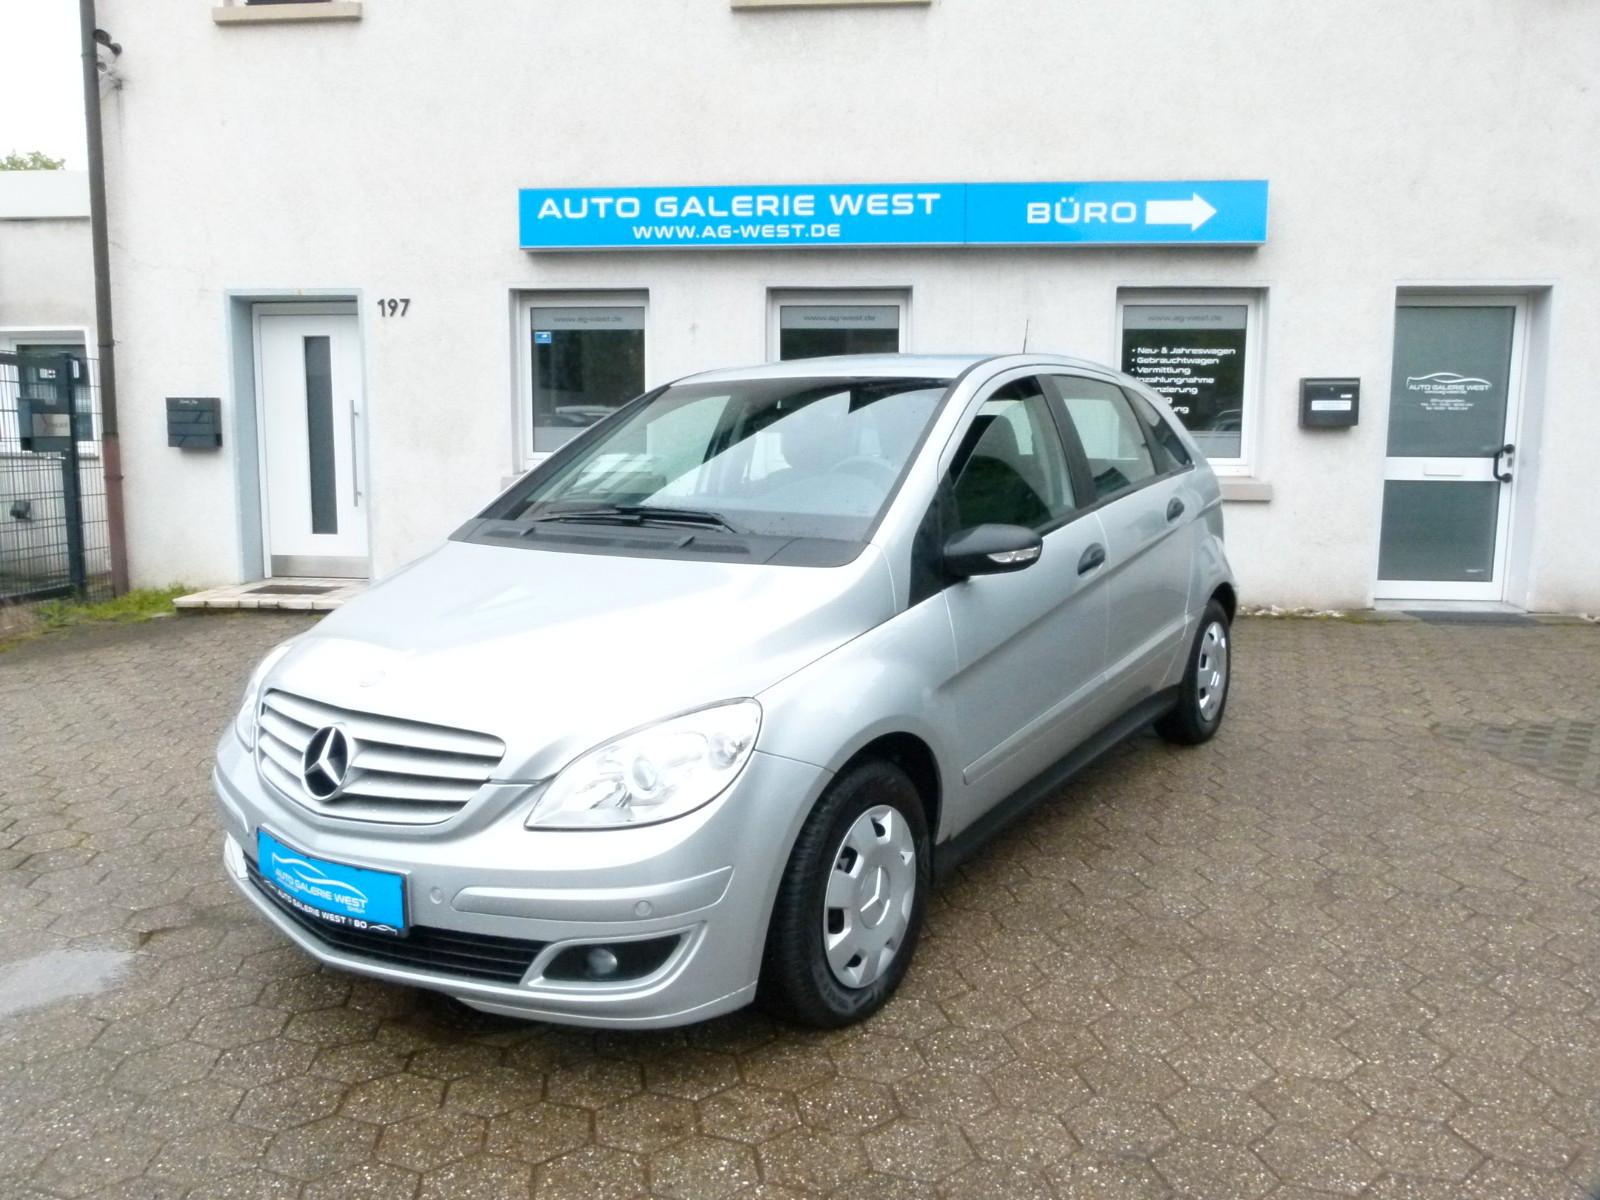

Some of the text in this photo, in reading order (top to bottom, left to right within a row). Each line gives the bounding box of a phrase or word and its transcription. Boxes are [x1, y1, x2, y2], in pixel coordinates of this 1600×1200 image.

[537, 192, 941, 219] AUTO GALERIE WEST
[1026, 196, 1137, 224] BÜRO
[633, 223, 841, 240] WWW.AG-WEST.DE
[376, 298, 411, 317] 197
[1170, 347, 1236, 356] Jahreswagen
[1137, 357, 1219, 366] Gebrauchtwagen
[1137, 367, 1191, 375] Vermittlung
[275, 869, 294, 886] AUTO
[294, 880, 333, 901] GALERIE
[335, 892, 368, 909] WEST
[321, 911, 346, 924] WEST
